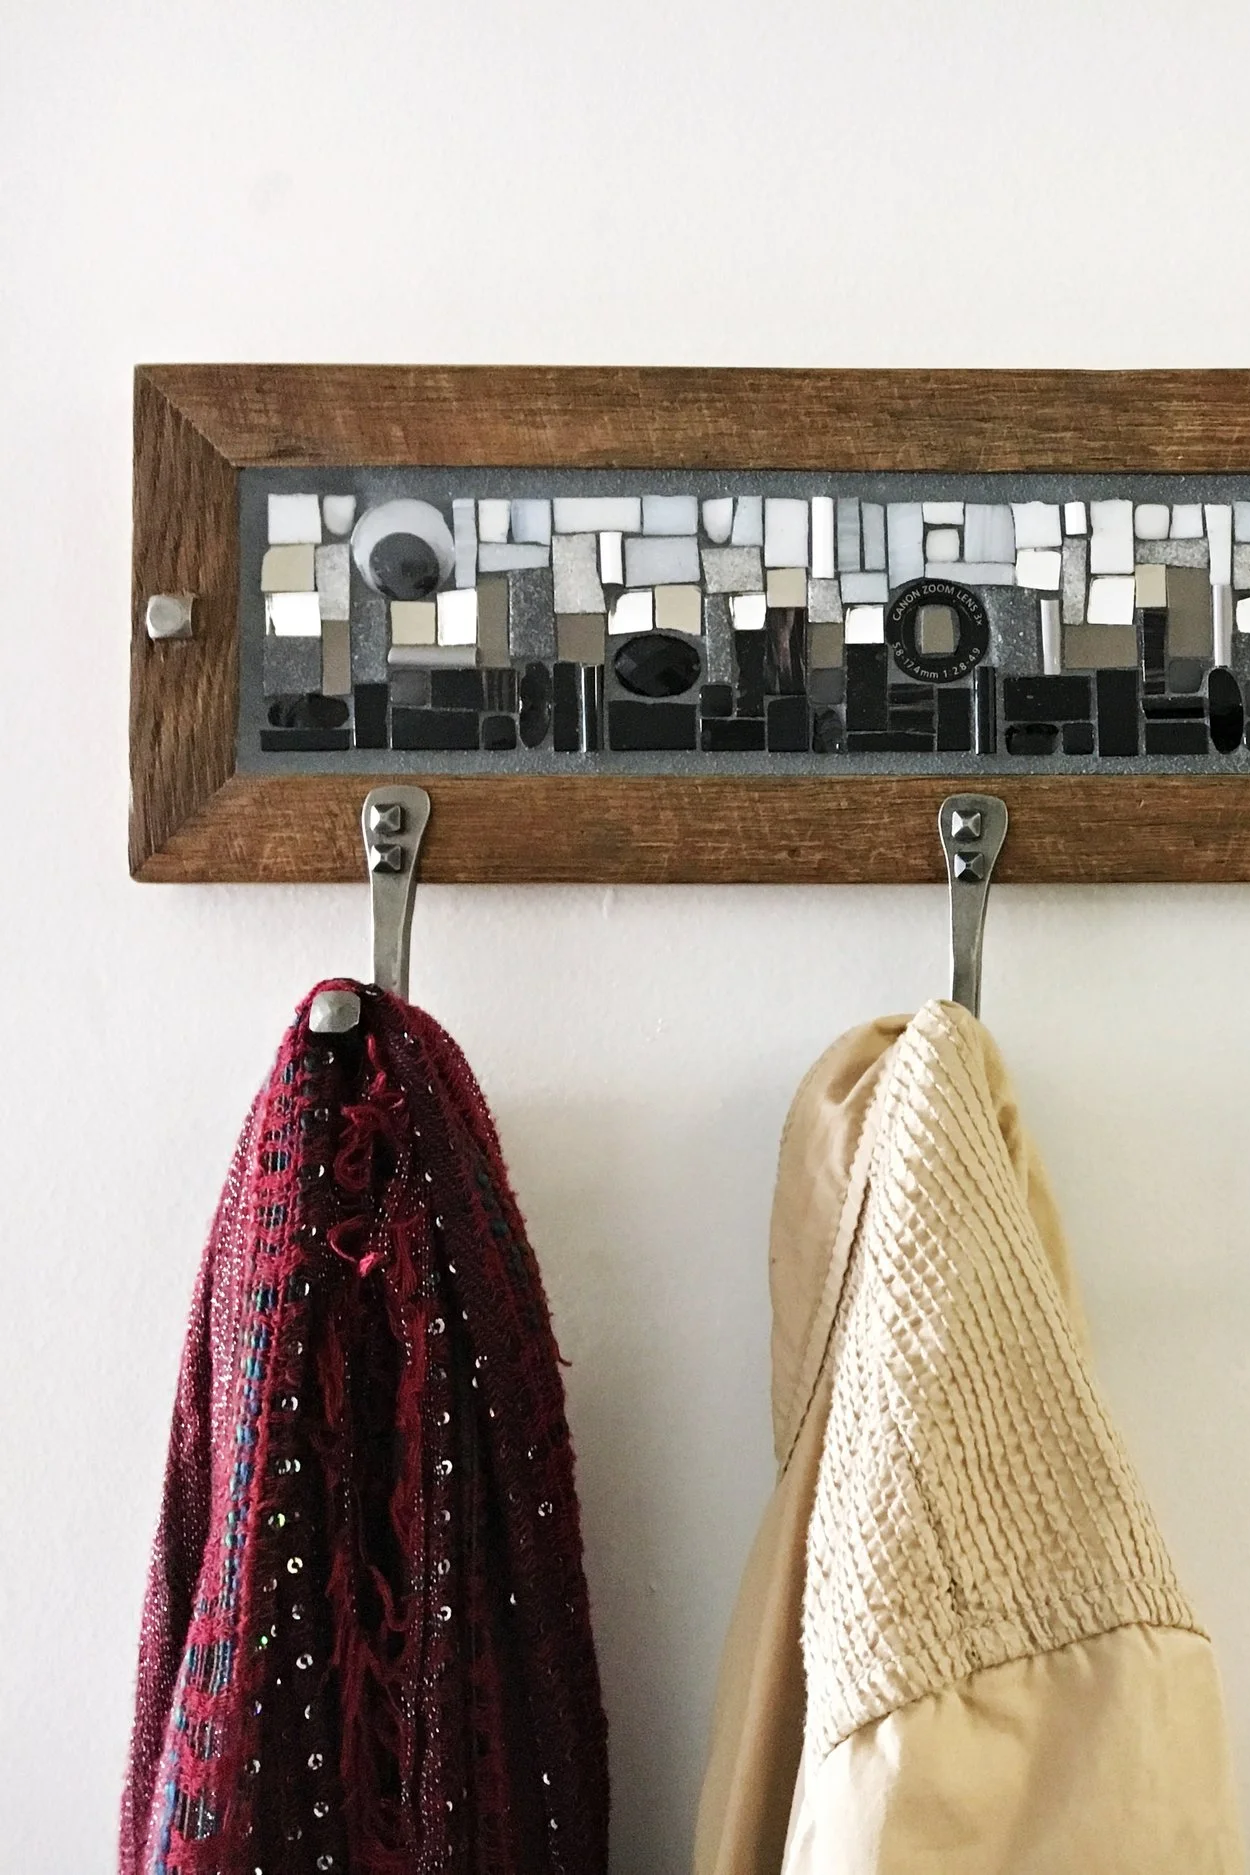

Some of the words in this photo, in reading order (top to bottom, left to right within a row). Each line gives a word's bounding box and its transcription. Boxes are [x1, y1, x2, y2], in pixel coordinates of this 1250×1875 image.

[892, 590, 920, 621] CANON
[921, 584, 955, 595] ZOOM
[956, 591, 979, 612] LENS
